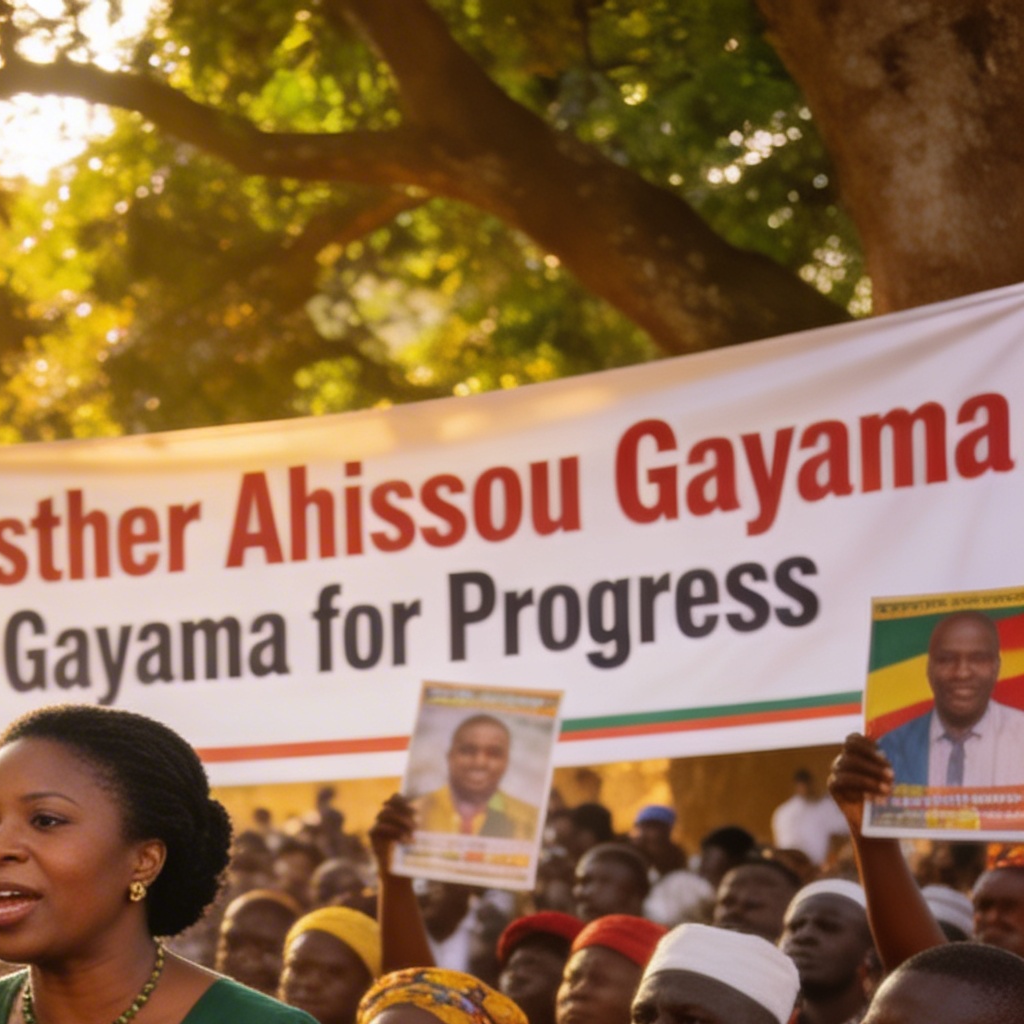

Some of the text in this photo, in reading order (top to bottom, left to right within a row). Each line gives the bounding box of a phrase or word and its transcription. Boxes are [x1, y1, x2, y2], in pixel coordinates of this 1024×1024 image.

[226, 456, 582, 569] Ahissou
[614, 391, 1016, 537] Gayama
[3, 555, 821, 707] Gayama for Progress
